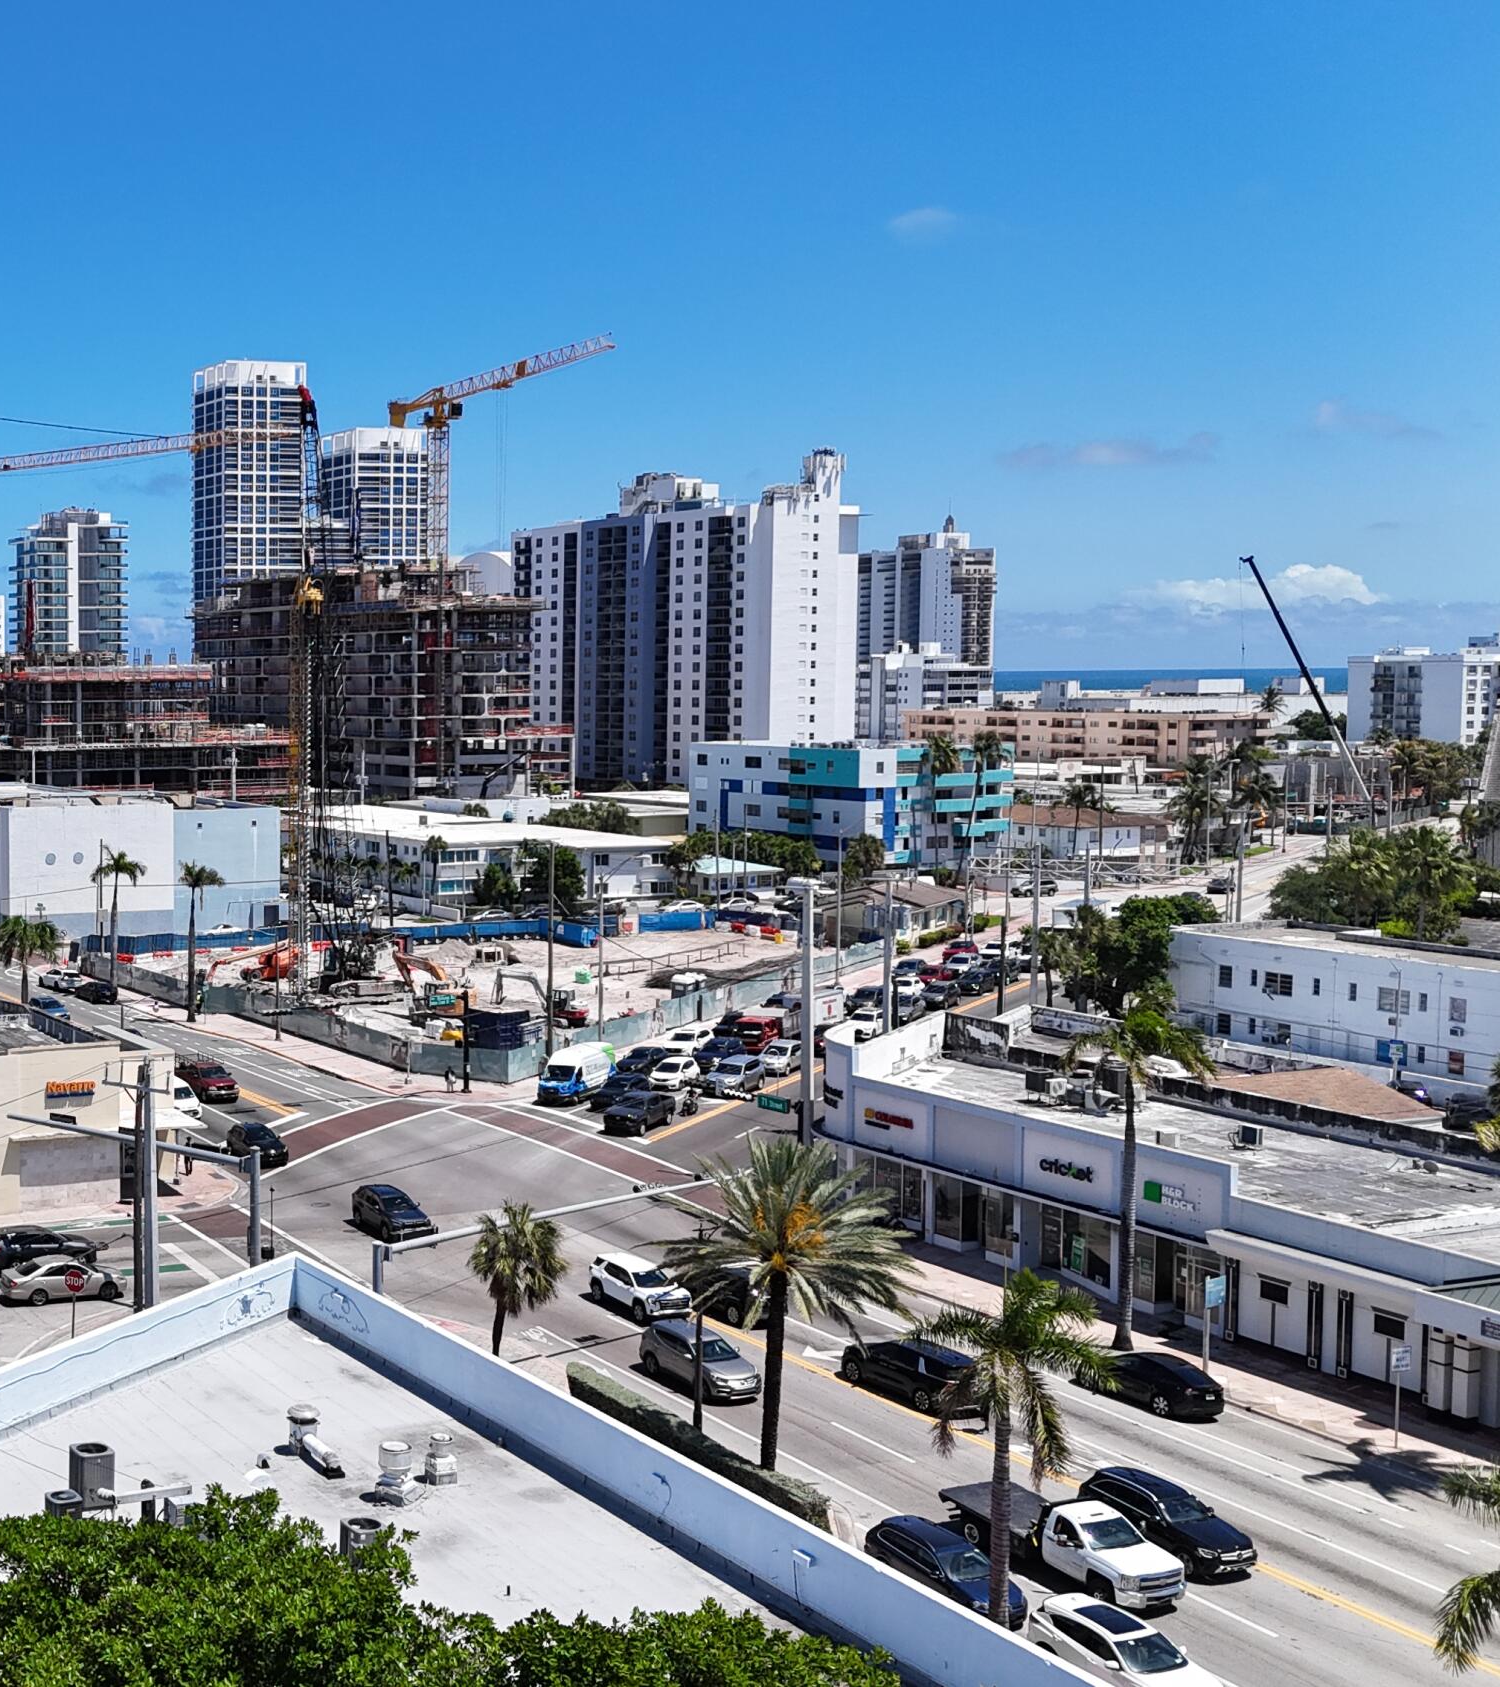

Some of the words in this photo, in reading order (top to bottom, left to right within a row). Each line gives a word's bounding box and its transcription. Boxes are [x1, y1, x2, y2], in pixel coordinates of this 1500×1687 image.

[46, 1081, 96, 1093] Navarro
[760, 1097, 768, 1107] 71
[769, 1100, 783, 1110] Street
[1039, 1158, 1094, 1183] cricket
[1161, 1185, 1183, 1198] H&R
[1161, 1196, 1195, 1212] BLOCK
[66, 1276, 84, 1287] STOP
